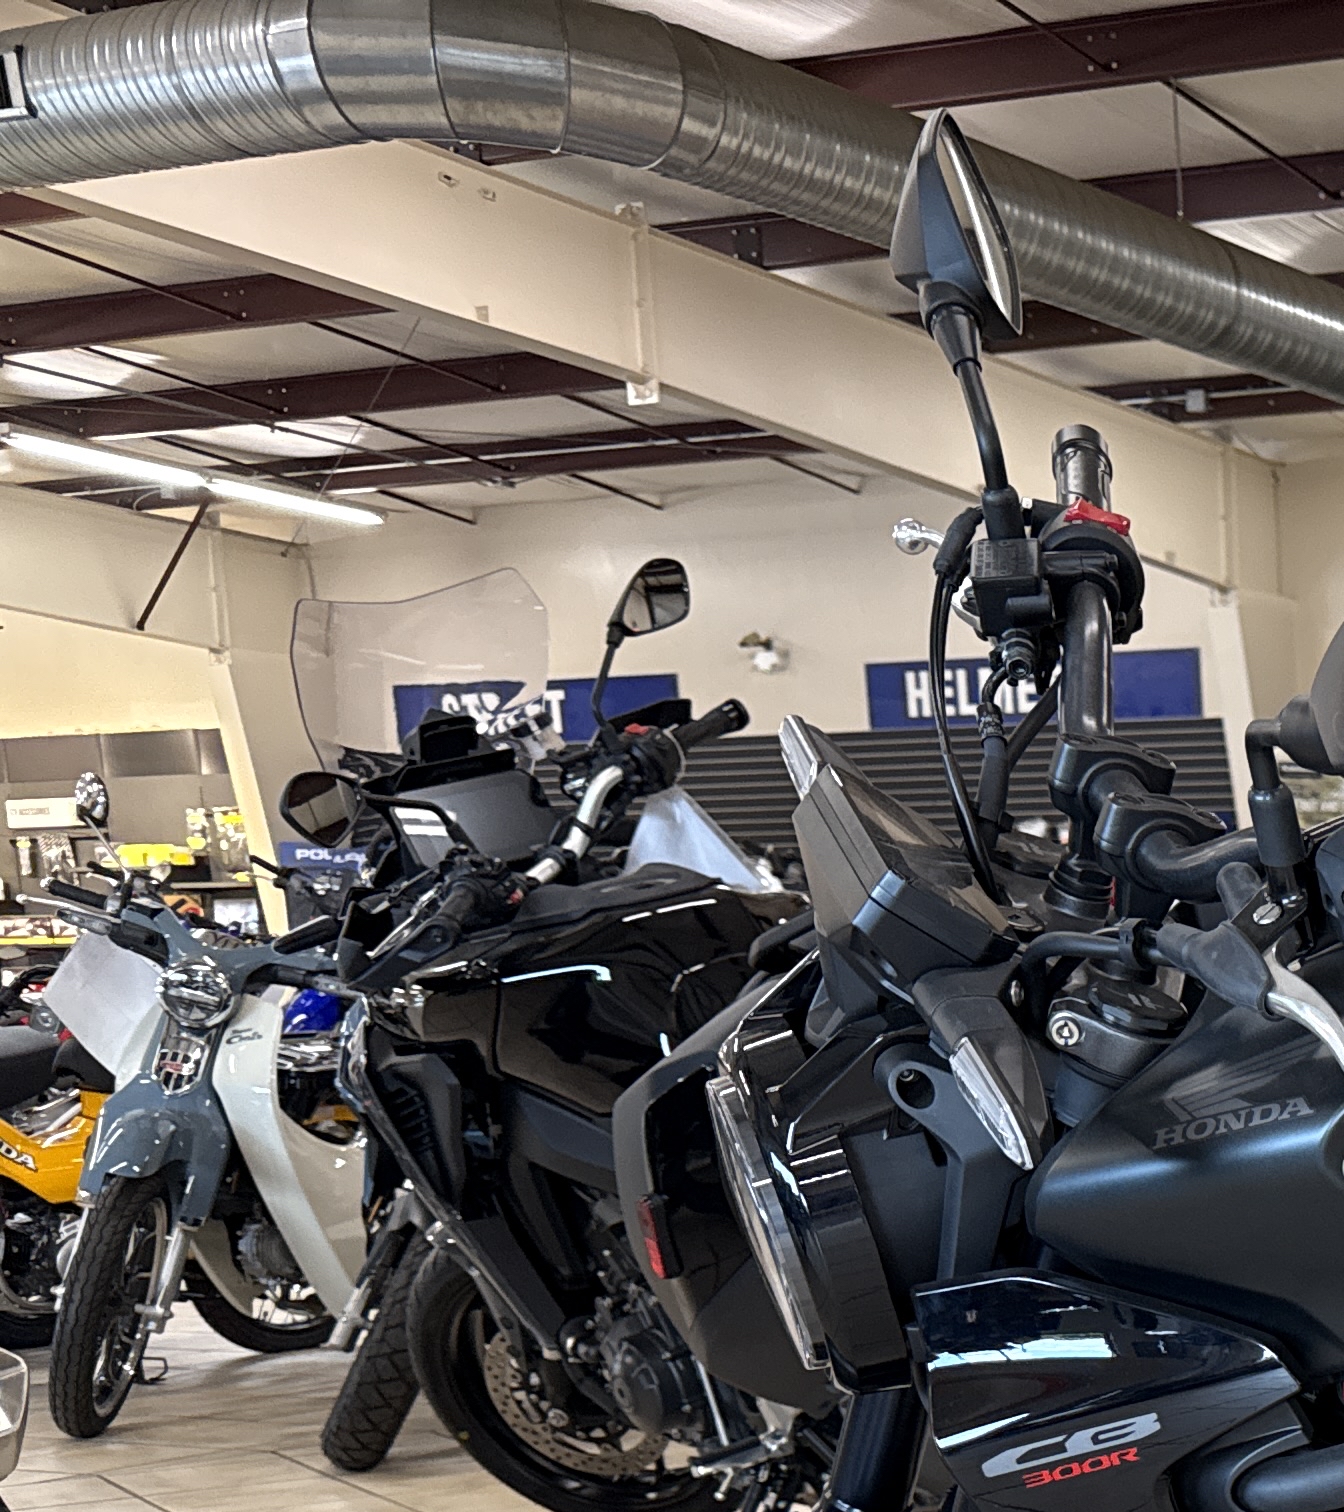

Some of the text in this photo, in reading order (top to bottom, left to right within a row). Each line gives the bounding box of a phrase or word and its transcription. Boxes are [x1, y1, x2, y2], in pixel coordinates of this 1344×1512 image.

[1152, 1096, 1315, 1150] HONDA
[981, 1412, 1161, 1478] CB
[1021, 1447, 1141, 1489] 300R
